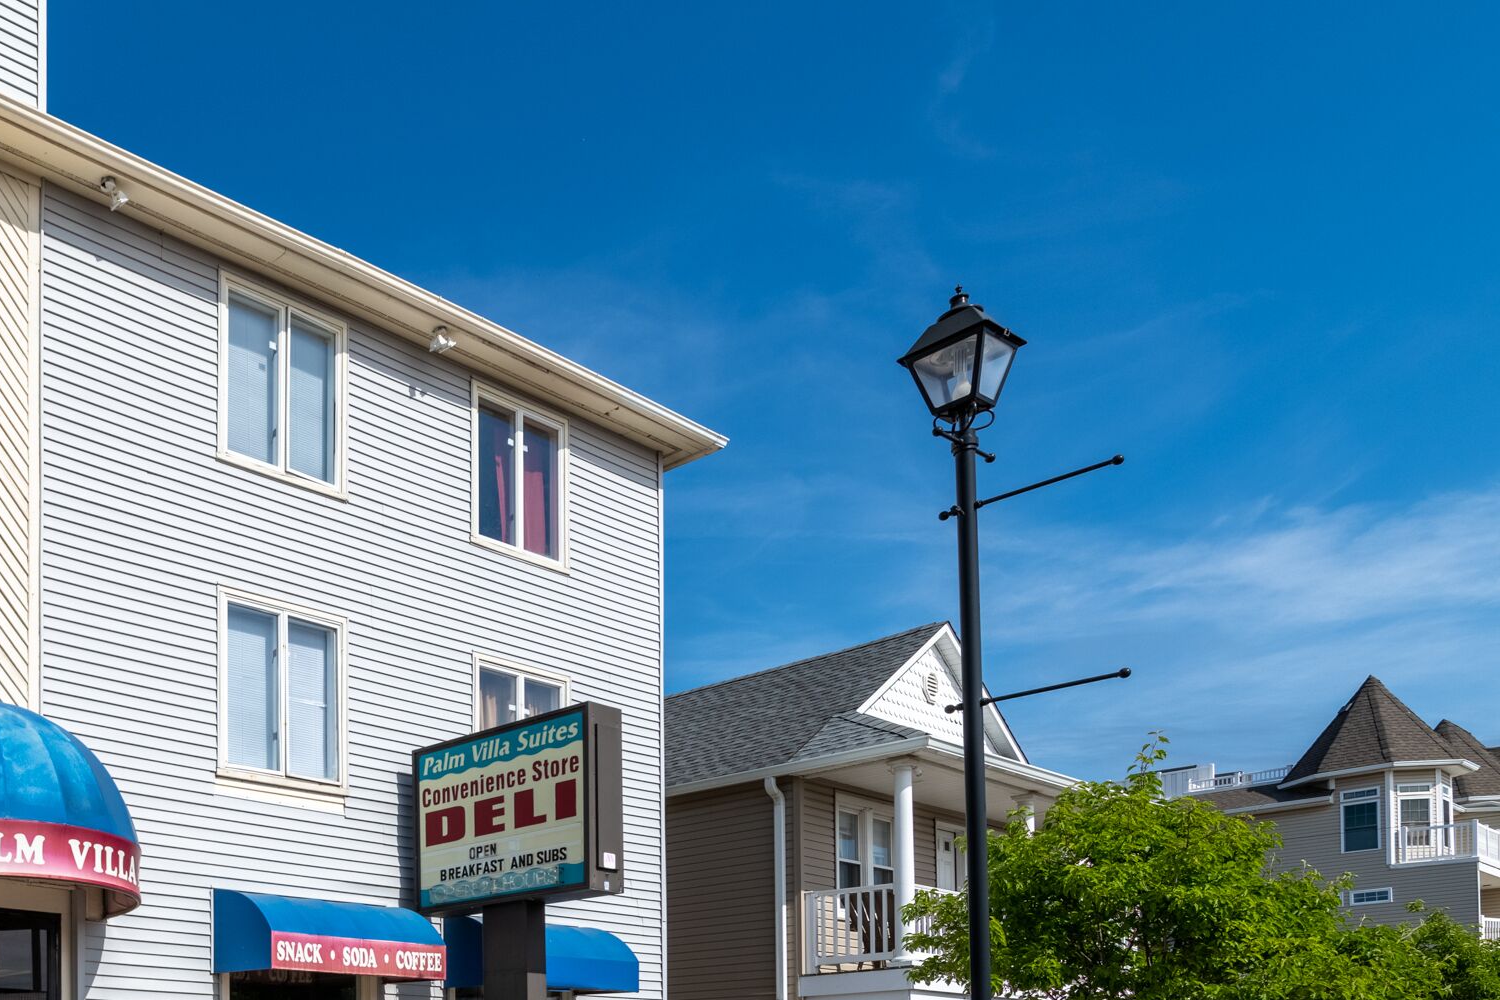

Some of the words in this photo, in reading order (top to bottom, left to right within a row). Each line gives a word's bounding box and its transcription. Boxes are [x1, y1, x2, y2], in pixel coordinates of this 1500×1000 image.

[423, 751, 465, 776] Palm
[472, 738, 510, 763] Villa
[516, 720, 579, 752] Suites
[422, 768, 526, 808] Convenience
[532, 754, 580, 782] Store
[425, 778, 577, 848] DELI
[67, 838, 138, 886] VILLA
[440, 858, 505, 882] BREAKFAST
[510, 853, 533, 870] AND
[536, 846, 567, 864] SUBS
[469, 843, 497, 860] OPEN
[276, 940, 323, 964] SNACK
[343, 946, 378, 969] SODA
[395, 949, 443, 972] COFFEE
